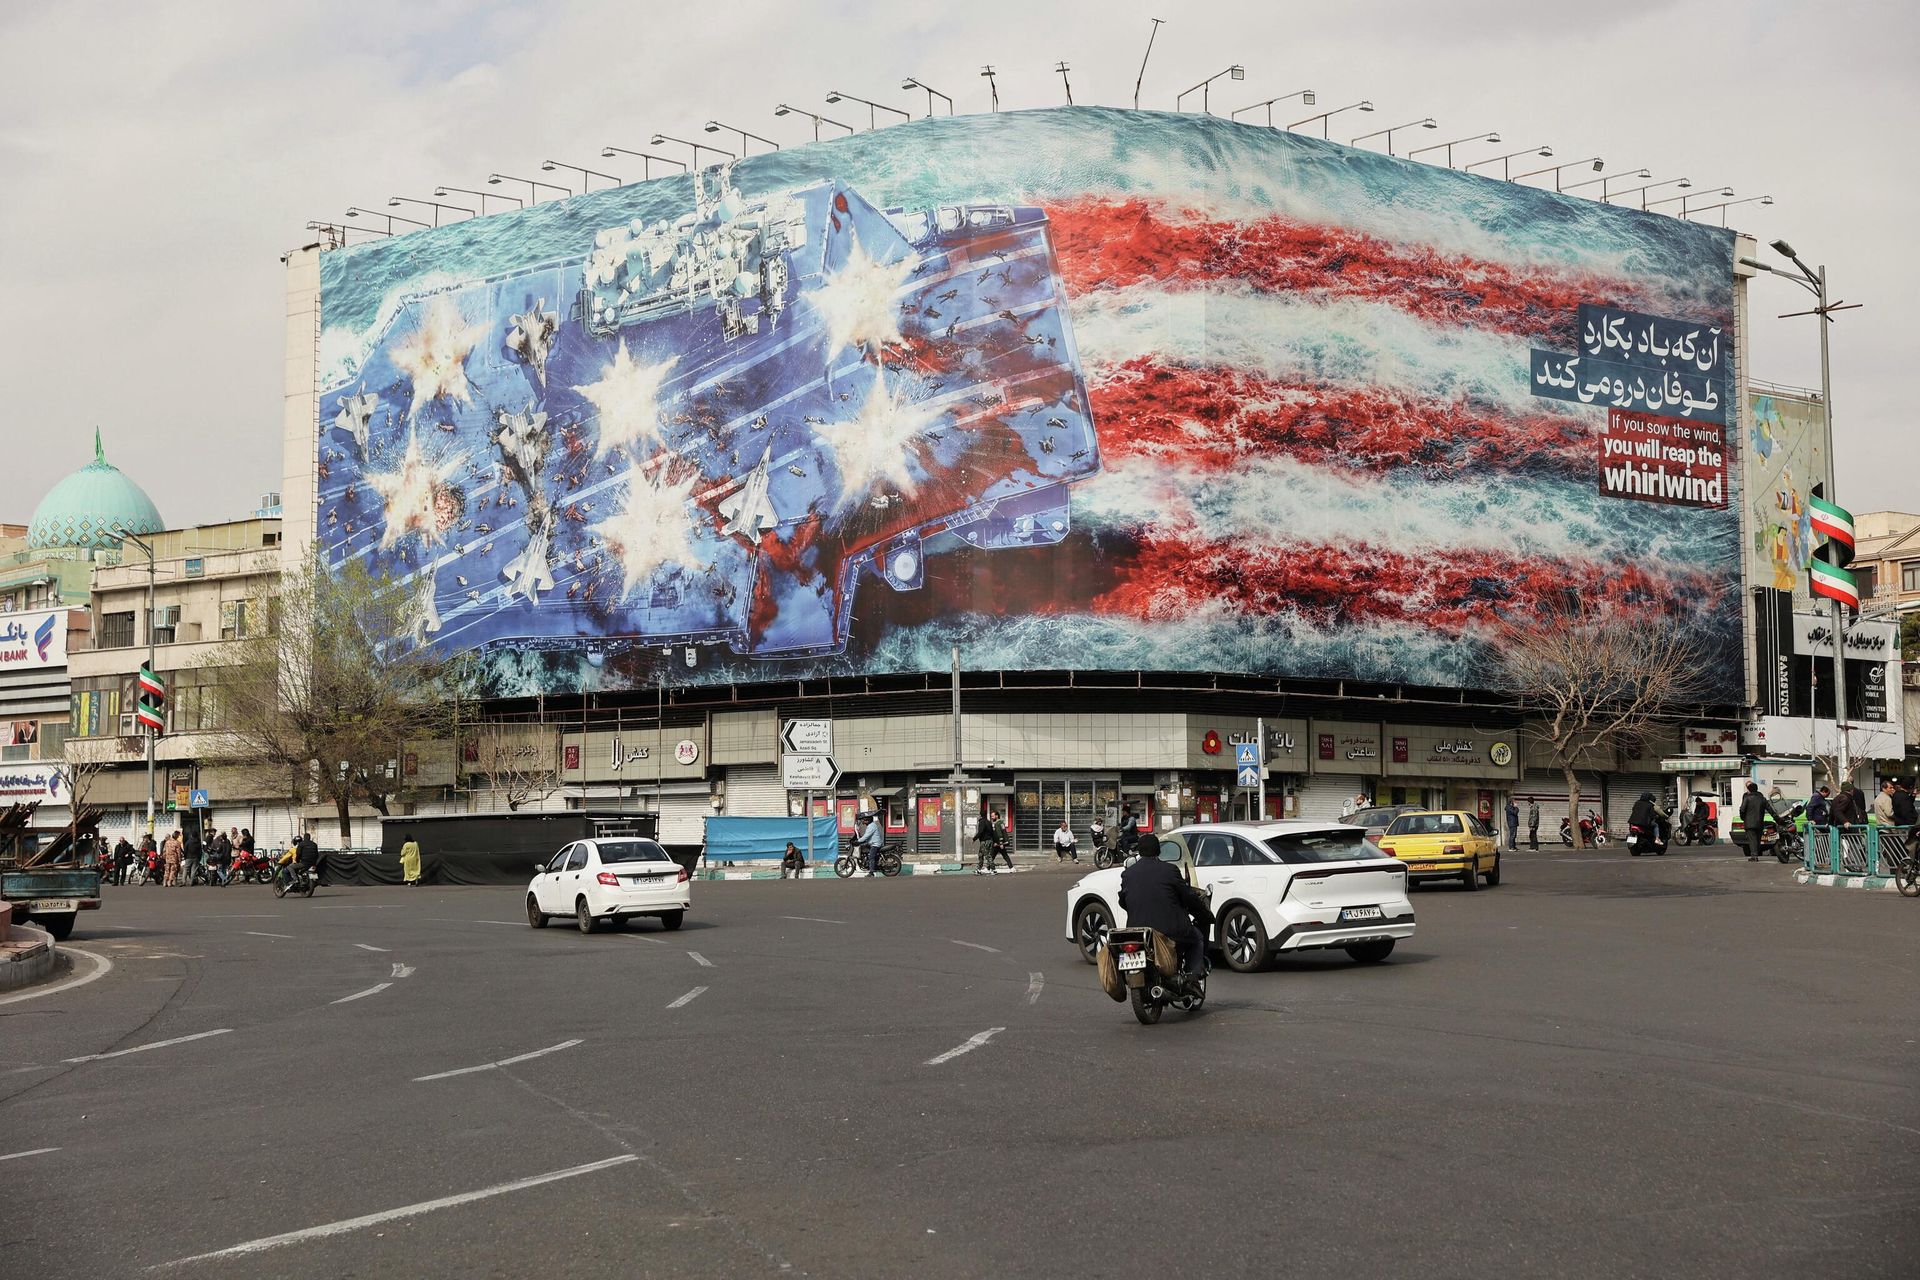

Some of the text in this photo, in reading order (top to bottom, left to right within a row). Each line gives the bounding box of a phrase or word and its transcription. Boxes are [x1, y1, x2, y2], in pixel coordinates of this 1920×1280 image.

[1584, 314, 1633, 360] بکارد
[1638, 323, 1670, 366] باد
[1645, 371, 1718, 416] طوفان
[1612, 415, 1722, 445] If you sow the wind,
[1604, 438, 1722, 469] you will reap the
[1605, 461, 1722, 504] whirlwind
[4, 649, 28, 662] BANK
[1870, 636, 1886, 650] مرکز
[1779, 654, 1790, 716] SAMSUNG
[625, 748, 648, 762] کفش
[1347, 747, 1376, 759] ساعتی
[1435, 740, 1473, 753] کفش ملی
